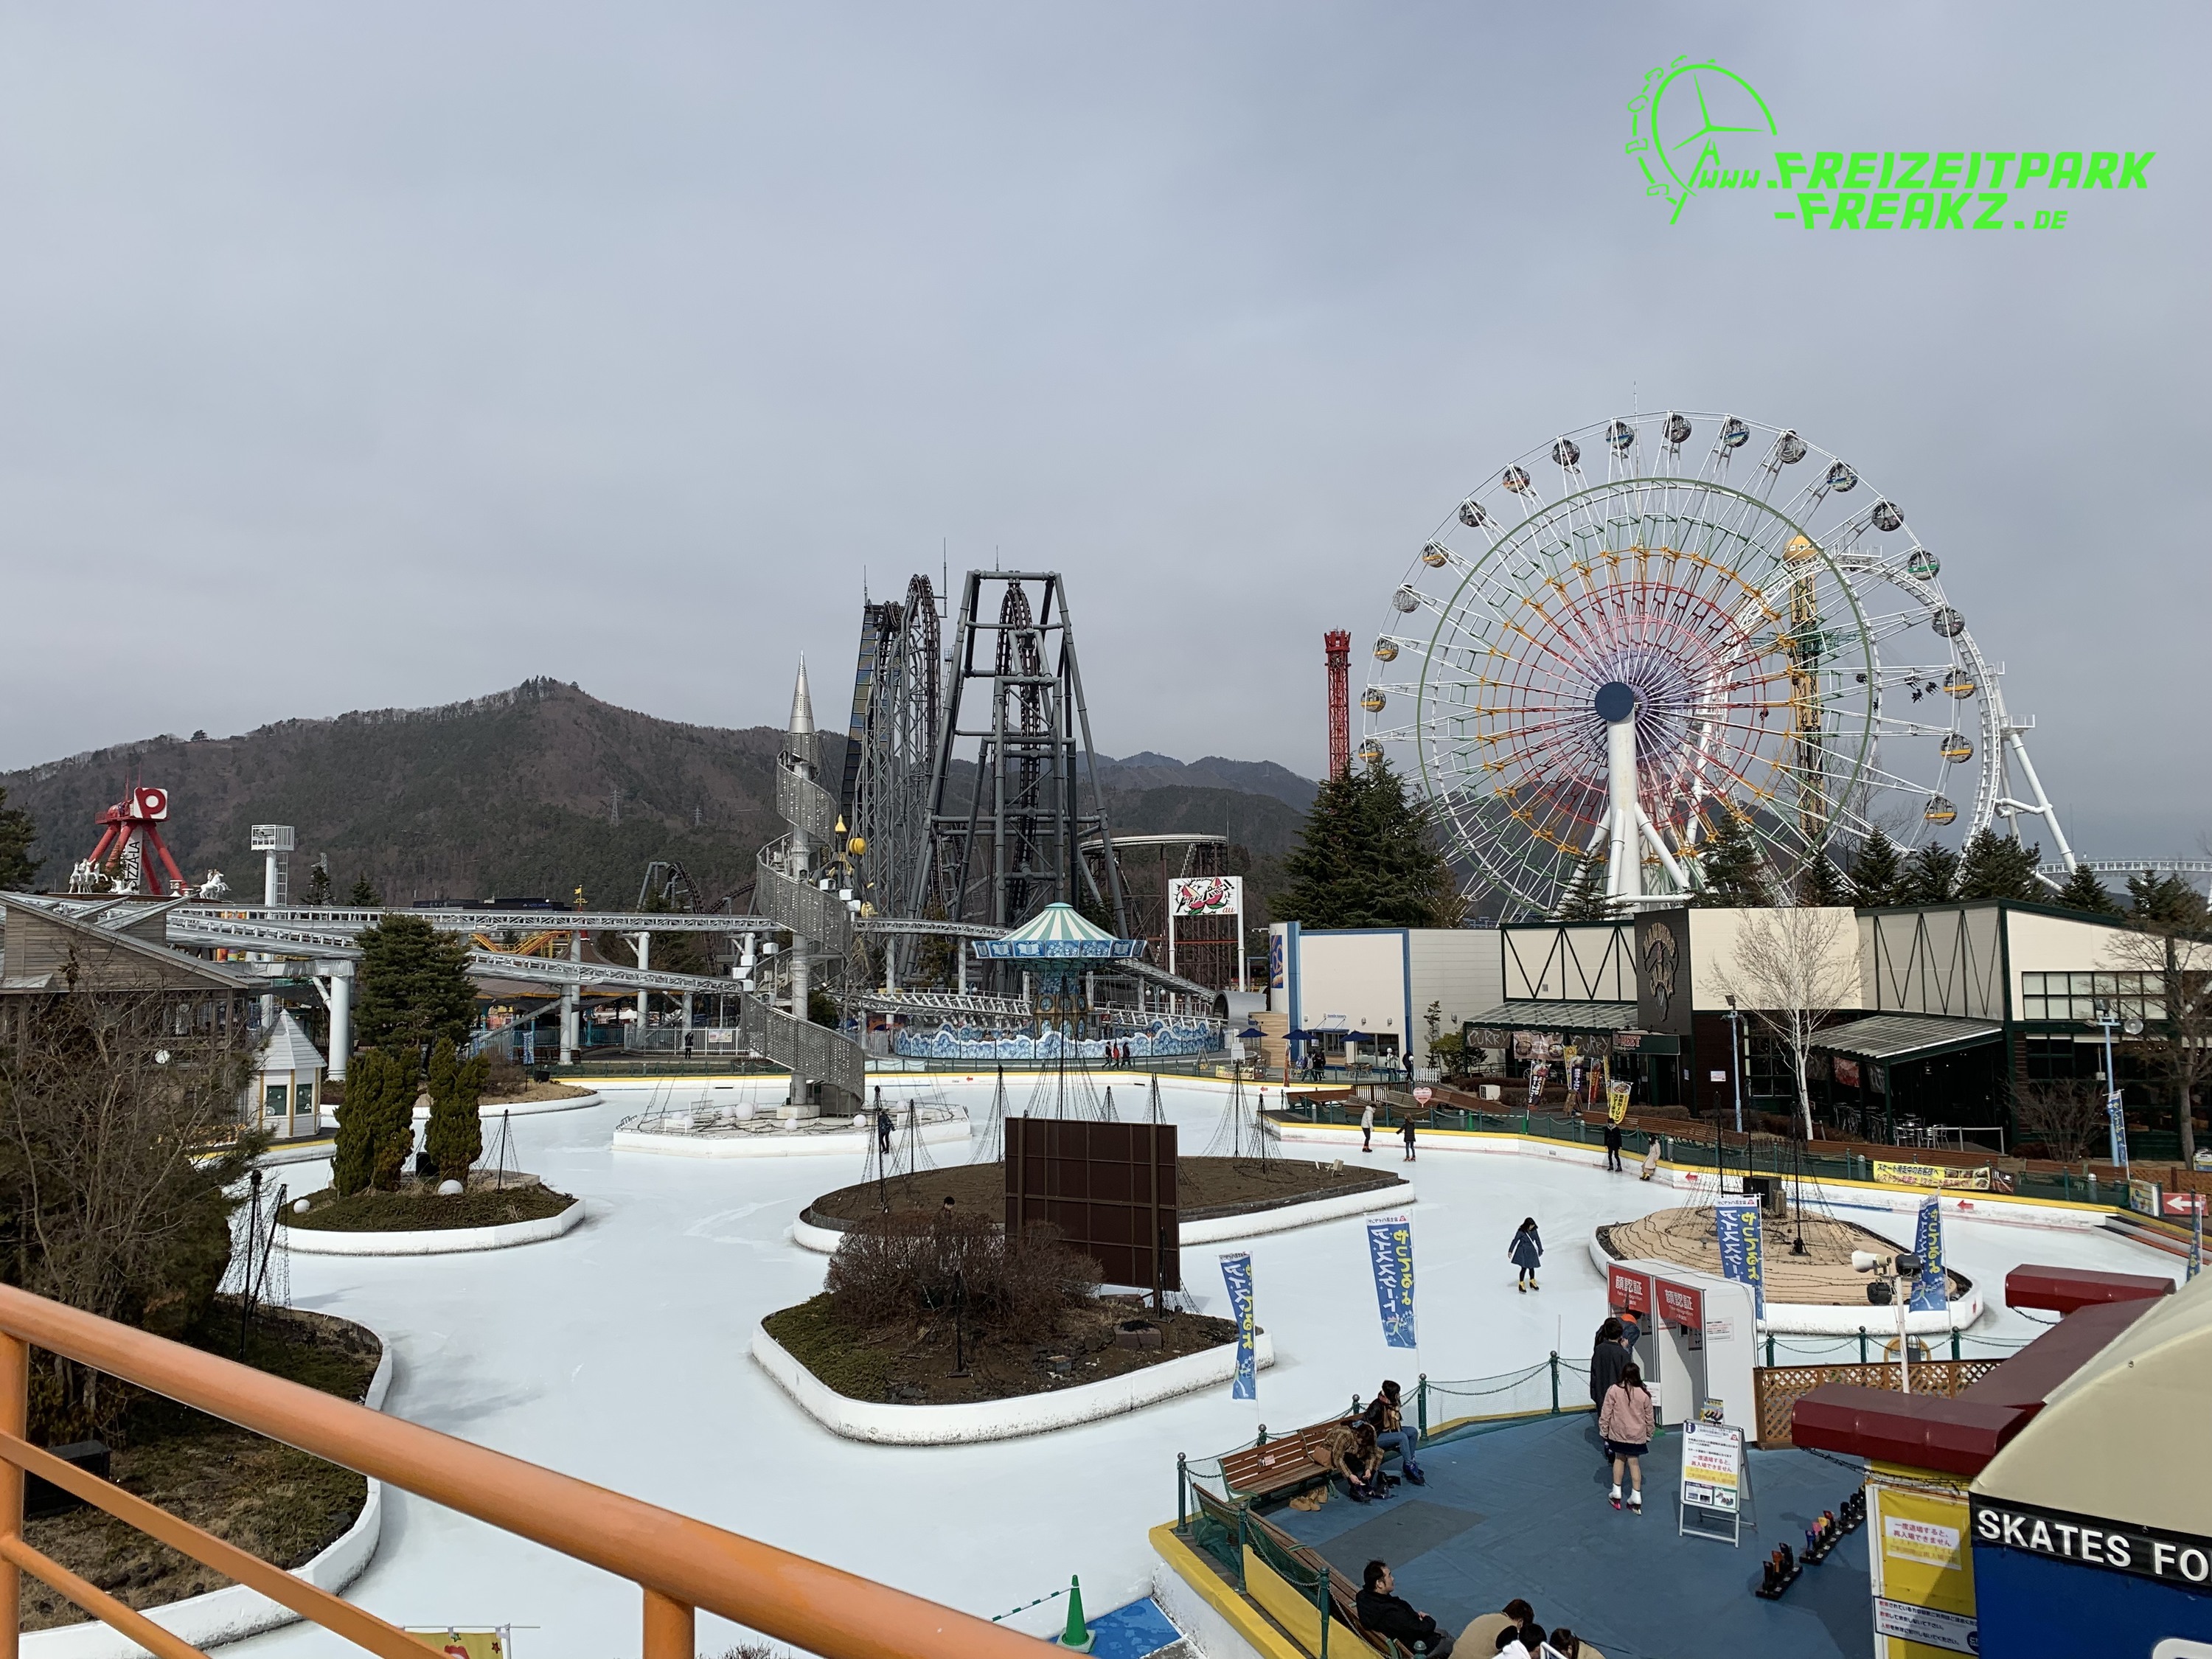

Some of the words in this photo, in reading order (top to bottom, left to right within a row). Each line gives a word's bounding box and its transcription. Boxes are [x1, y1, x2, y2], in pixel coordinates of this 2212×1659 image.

[1615, 1275, 1644, 1295] 顔認証
[1664, 1289, 1694, 1310] 顔認証
[1978, 1509, 2132, 1568] SKATES
[2154, 1543, 2212, 1582] FO
